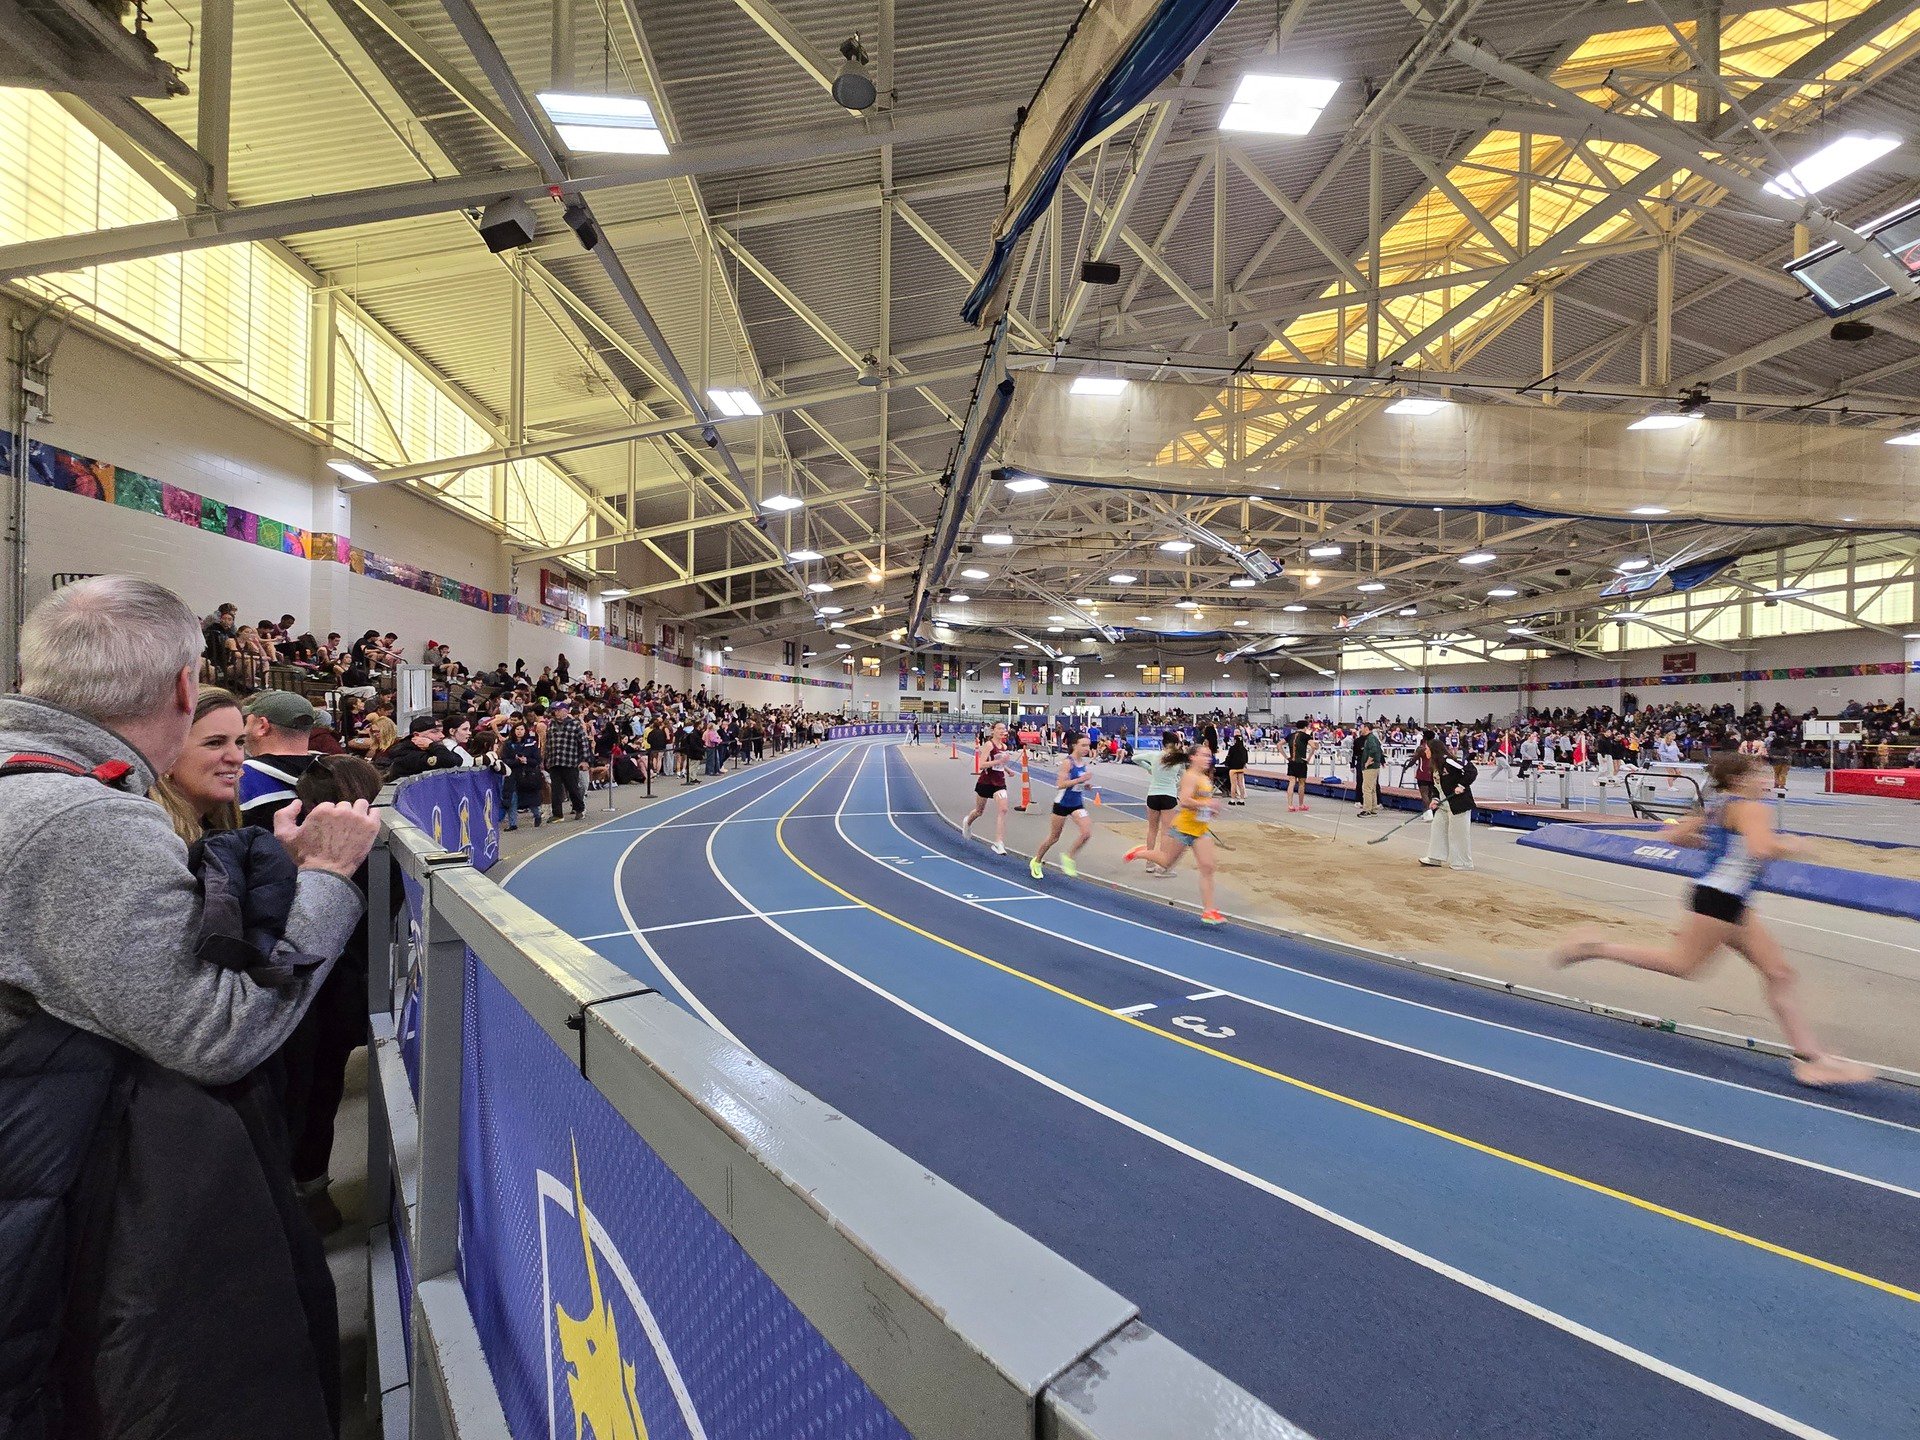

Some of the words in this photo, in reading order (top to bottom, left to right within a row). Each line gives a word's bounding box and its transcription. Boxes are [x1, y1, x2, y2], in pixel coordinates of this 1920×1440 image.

[1874, 775, 1906, 787] UCS
[1633, 845, 1681, 859] GILL
[1171, 1015, 1237, 1039] 3
